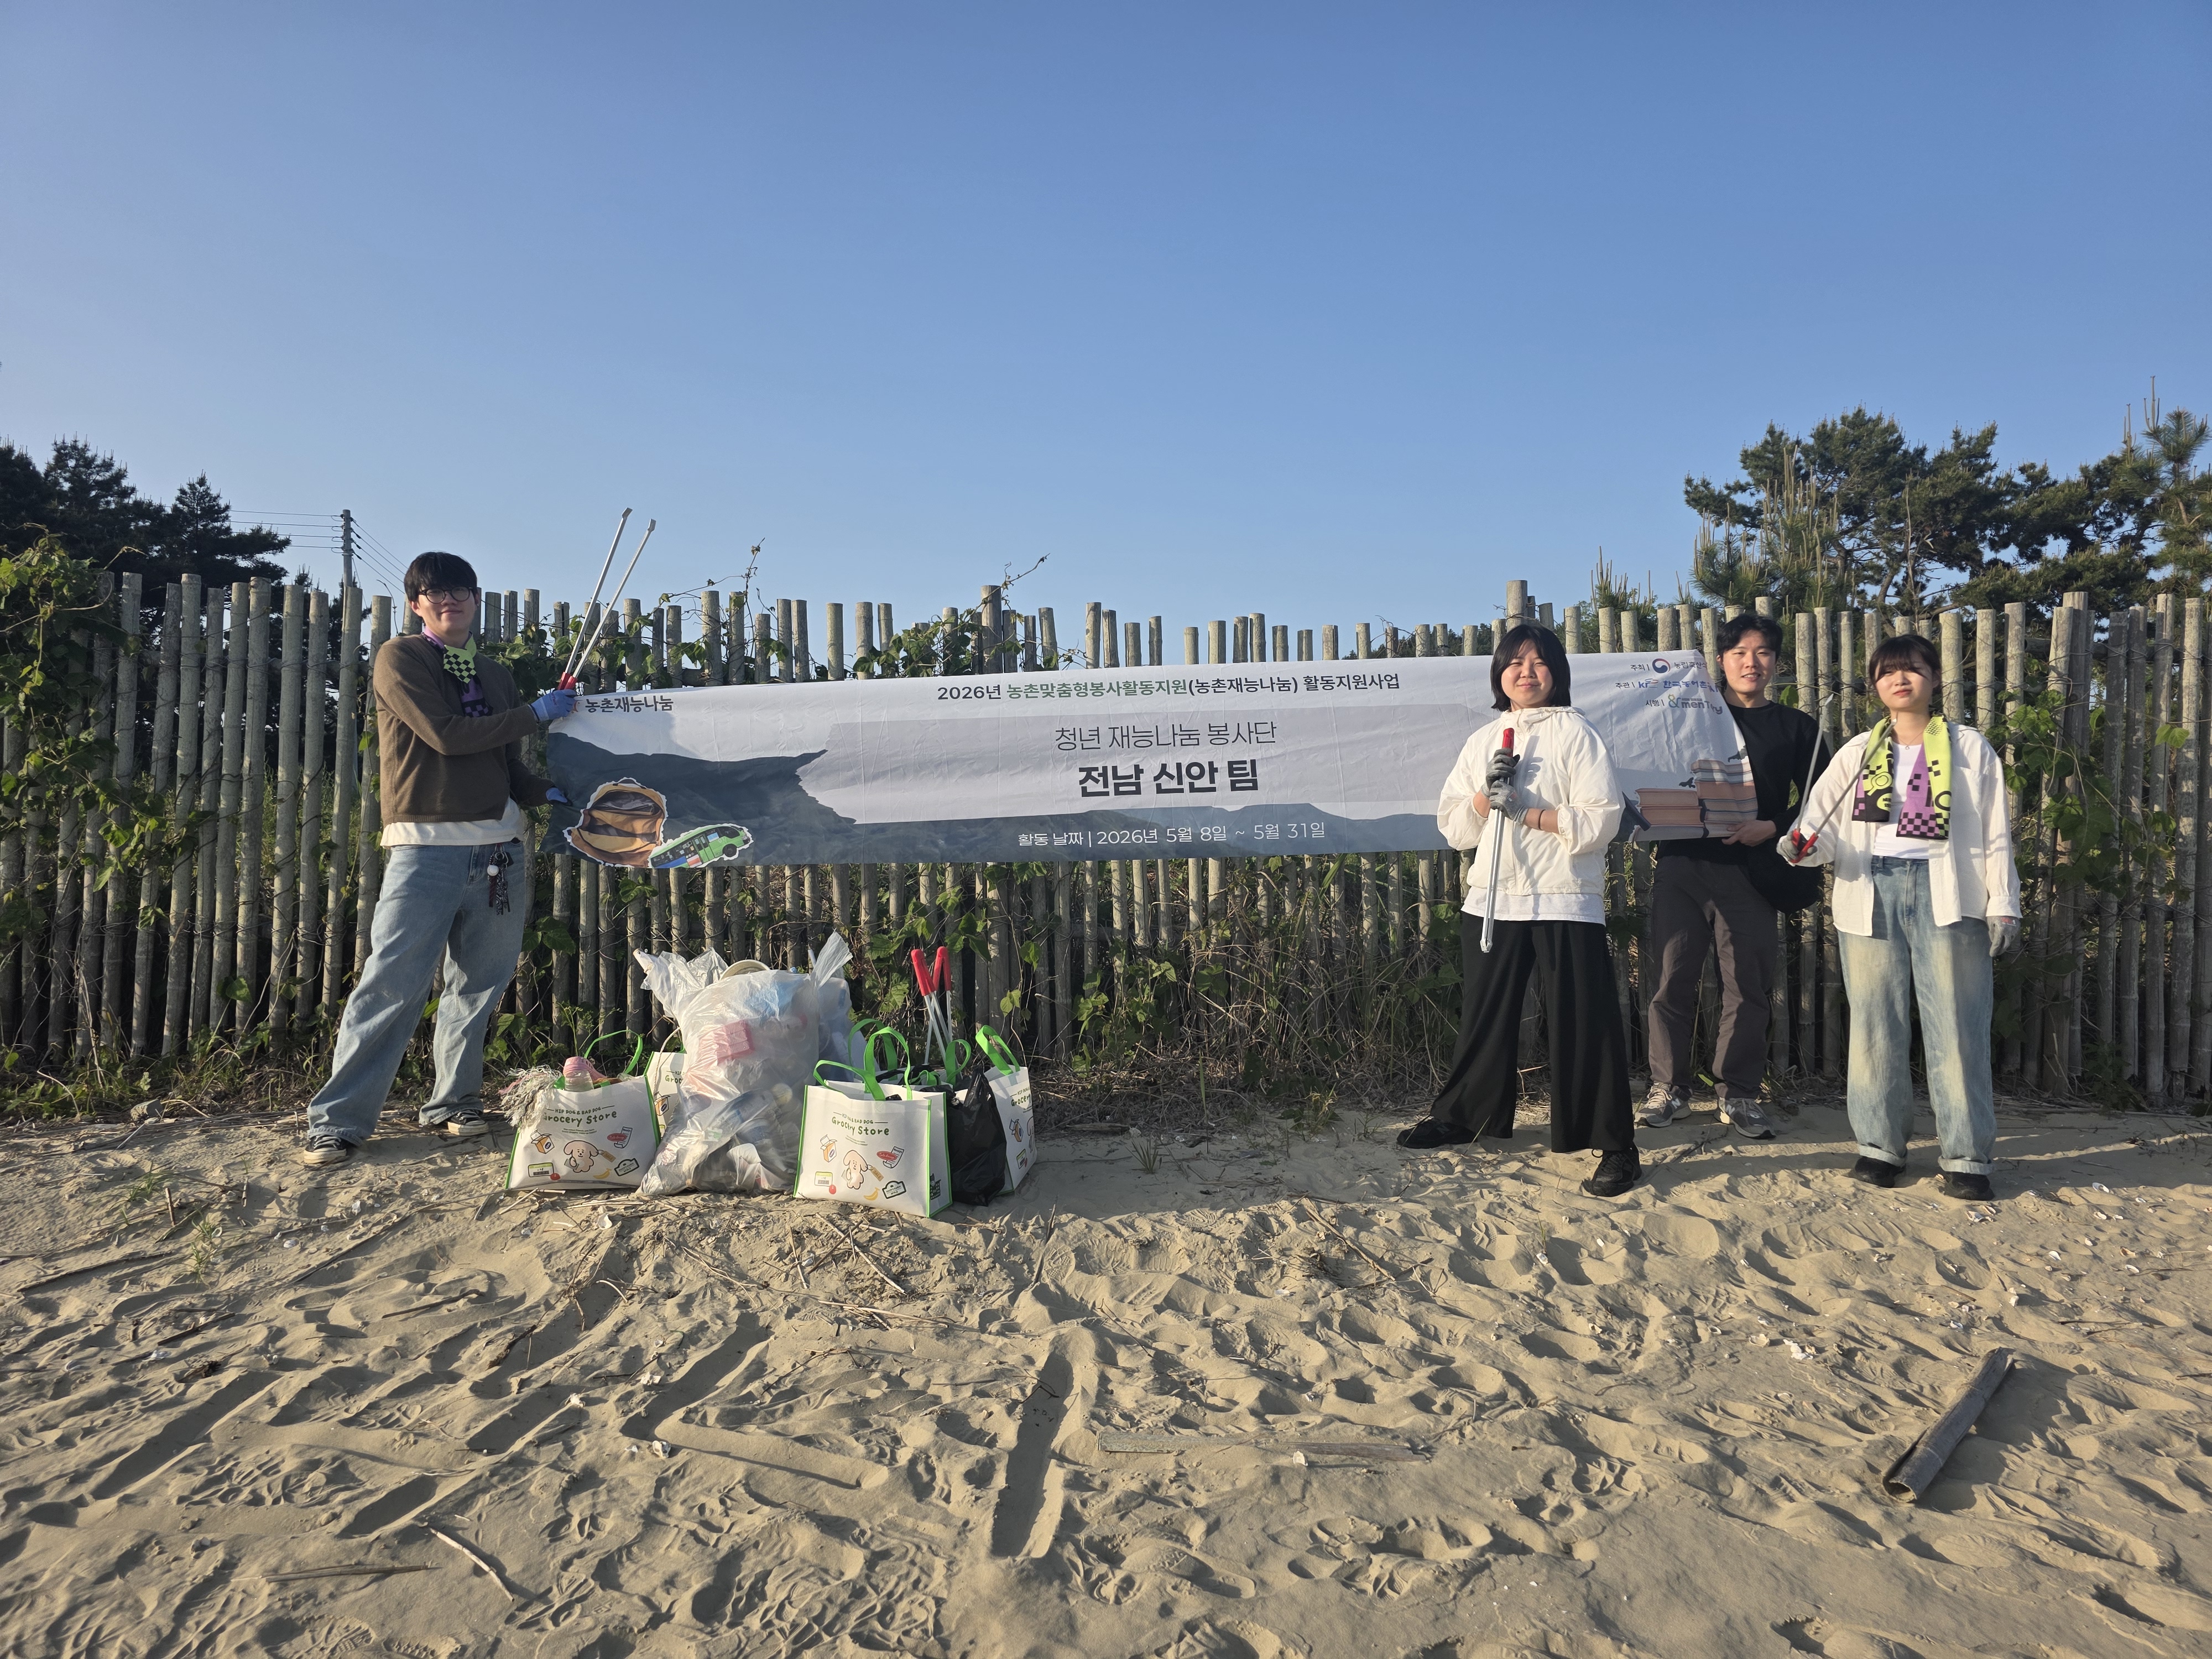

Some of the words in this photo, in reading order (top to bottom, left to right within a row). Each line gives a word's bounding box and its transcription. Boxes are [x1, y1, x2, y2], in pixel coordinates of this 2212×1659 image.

[937, 685, 1001, 700] 2026년
[1006, 677, 1298, 699] 농촌맞춤형봉사활동지원(농촌재능나눔)
[1303, 674, 1400, 691] 활동지원사업
[1663, 680, 1719, 692] 한국농어촌사
[585, 695, 674, 713] 농촌재능나눔
[1055, 727, 1101, 751] 청년
[1108, 724, 1201, 748] 재능나눔
[1207, 721, 1277, 745] 봉사단
[1078, 764, 1144, 797] 전남
[1154, 761, 1218, 794] 신안
[1227, 759, 1259, 792] 팀
[1018, 833, 1049, 846] 활동
[1053, 832, 1084, 846] 날짜
[1097, 828, 1158, 844] 2026년
[1166, 827, 1192, 842] 5월
[1200, 826, 1227, 841] 8일
[1254, 824, 1280, 839] 5월
[1287, 822, 1325, 838] 31일
[586, 1111, 617, 1124] Store
[858, 1126, 889, 1135] Store
